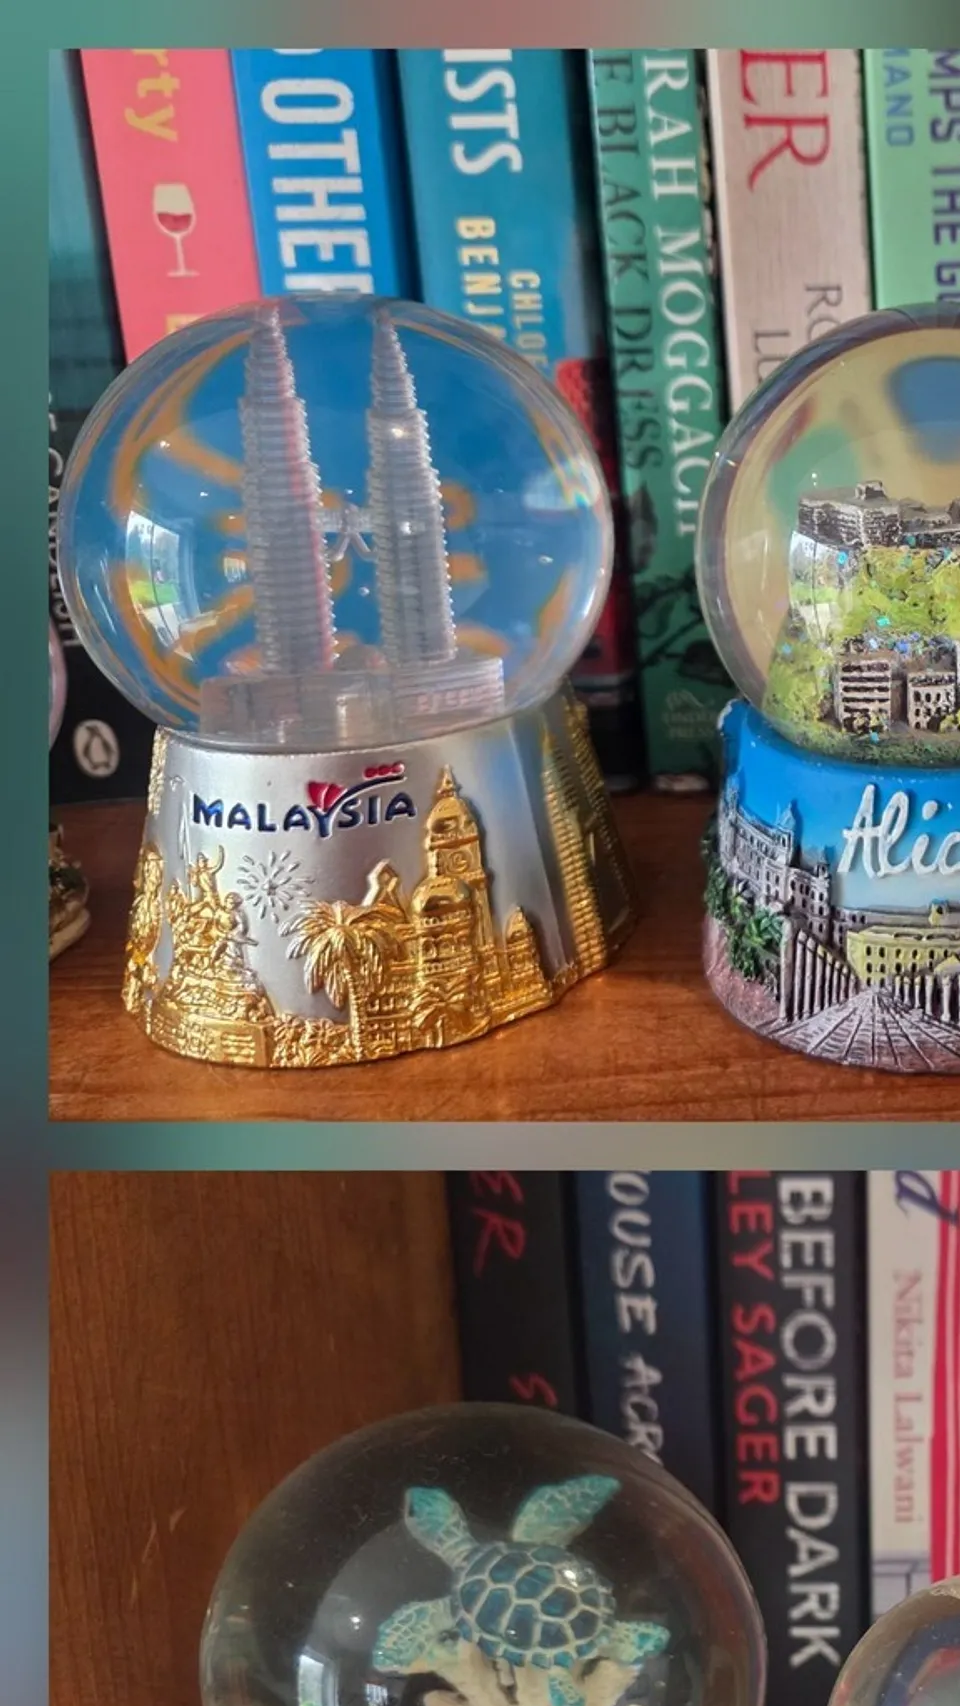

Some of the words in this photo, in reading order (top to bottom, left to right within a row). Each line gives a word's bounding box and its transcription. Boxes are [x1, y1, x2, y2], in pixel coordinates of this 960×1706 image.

[597, 103, 650, 284] BLACK
[612, 305, 664, 471] DRESS
[191, 786, 416, 838] MALAYSIA
[731, 1303, 781, 1505] SAGER
[778, 1176, 838, 1462] BEFORE
[893, 1267, 924, 1381] Nikita
[893, 1389, 923, 1524] Lalwani
[784, 1481, 840, 1668] DARK
